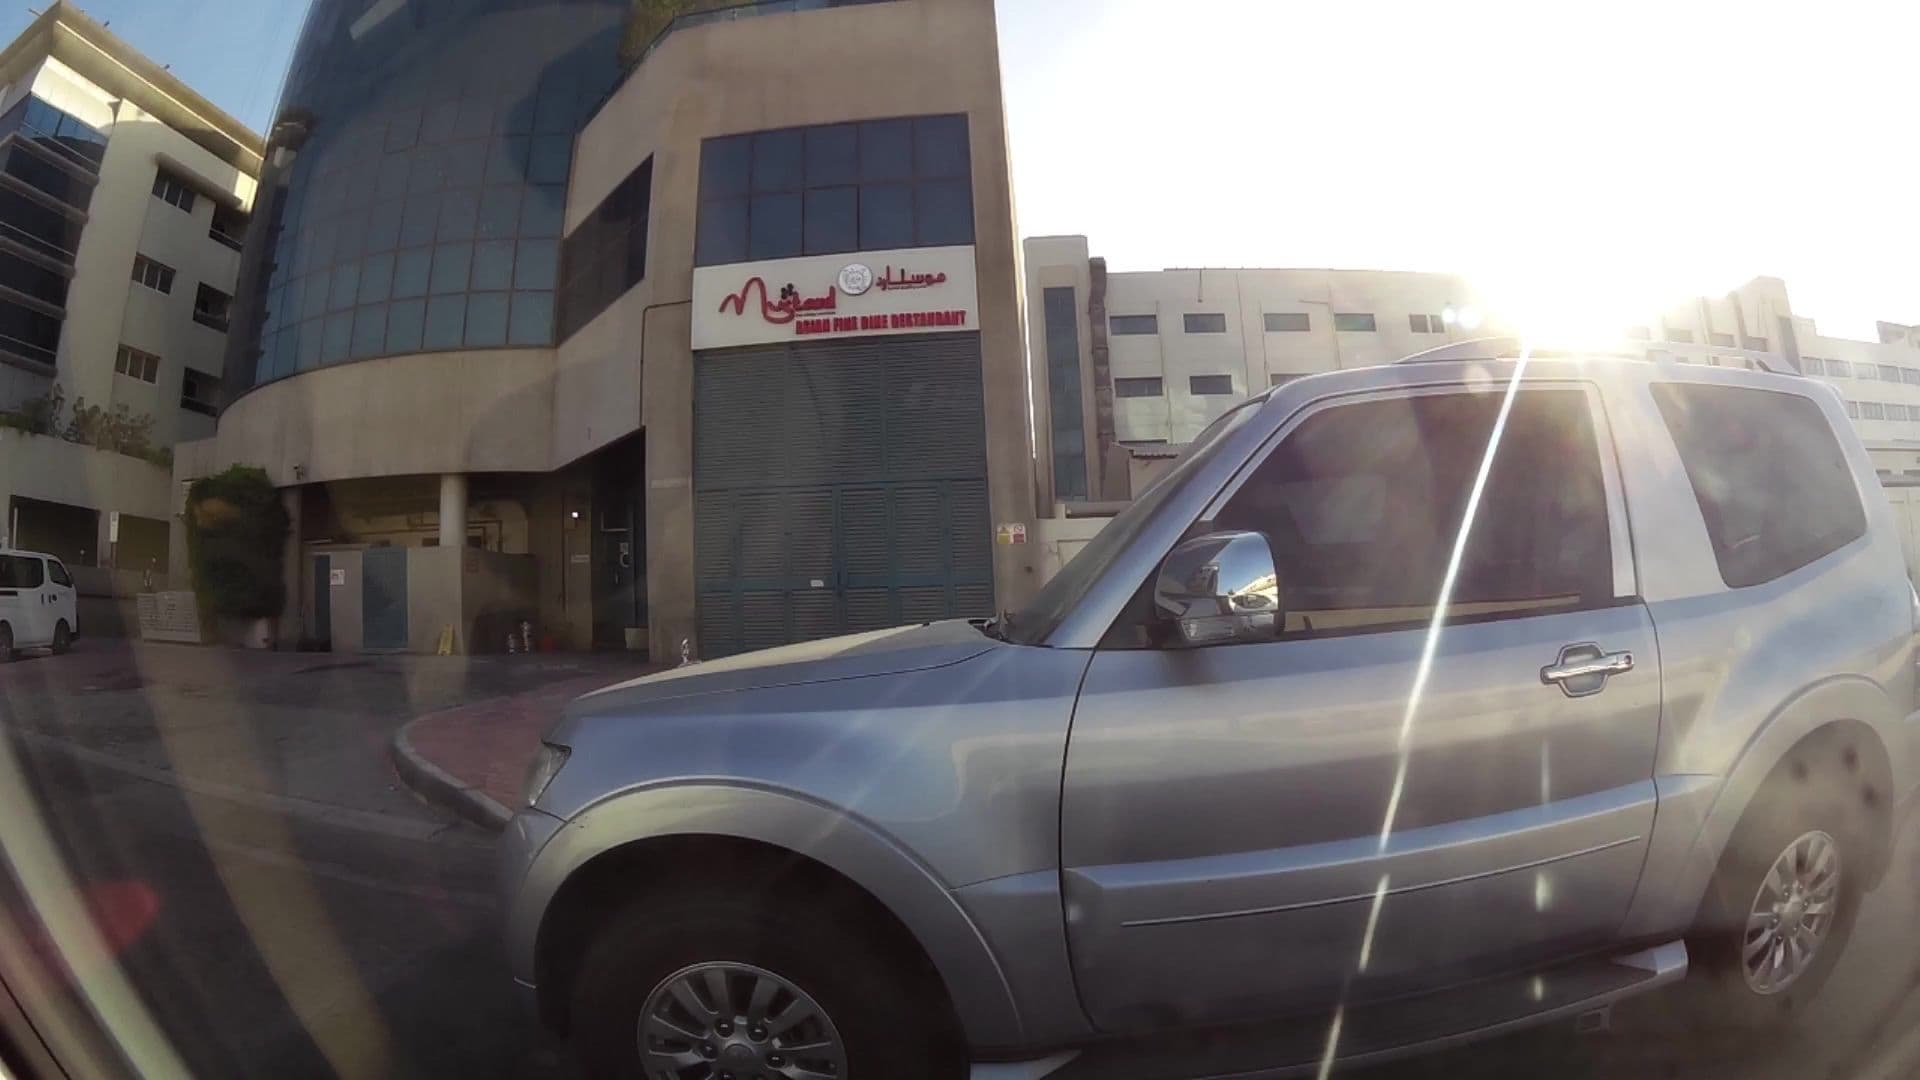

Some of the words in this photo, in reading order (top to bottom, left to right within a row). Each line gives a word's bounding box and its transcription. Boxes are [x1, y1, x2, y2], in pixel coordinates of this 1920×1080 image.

[834, 316, 858, 332] FINE
[861, 314, 888, 330] DINE
[891, 310, 967, 329] RESTAURANT
